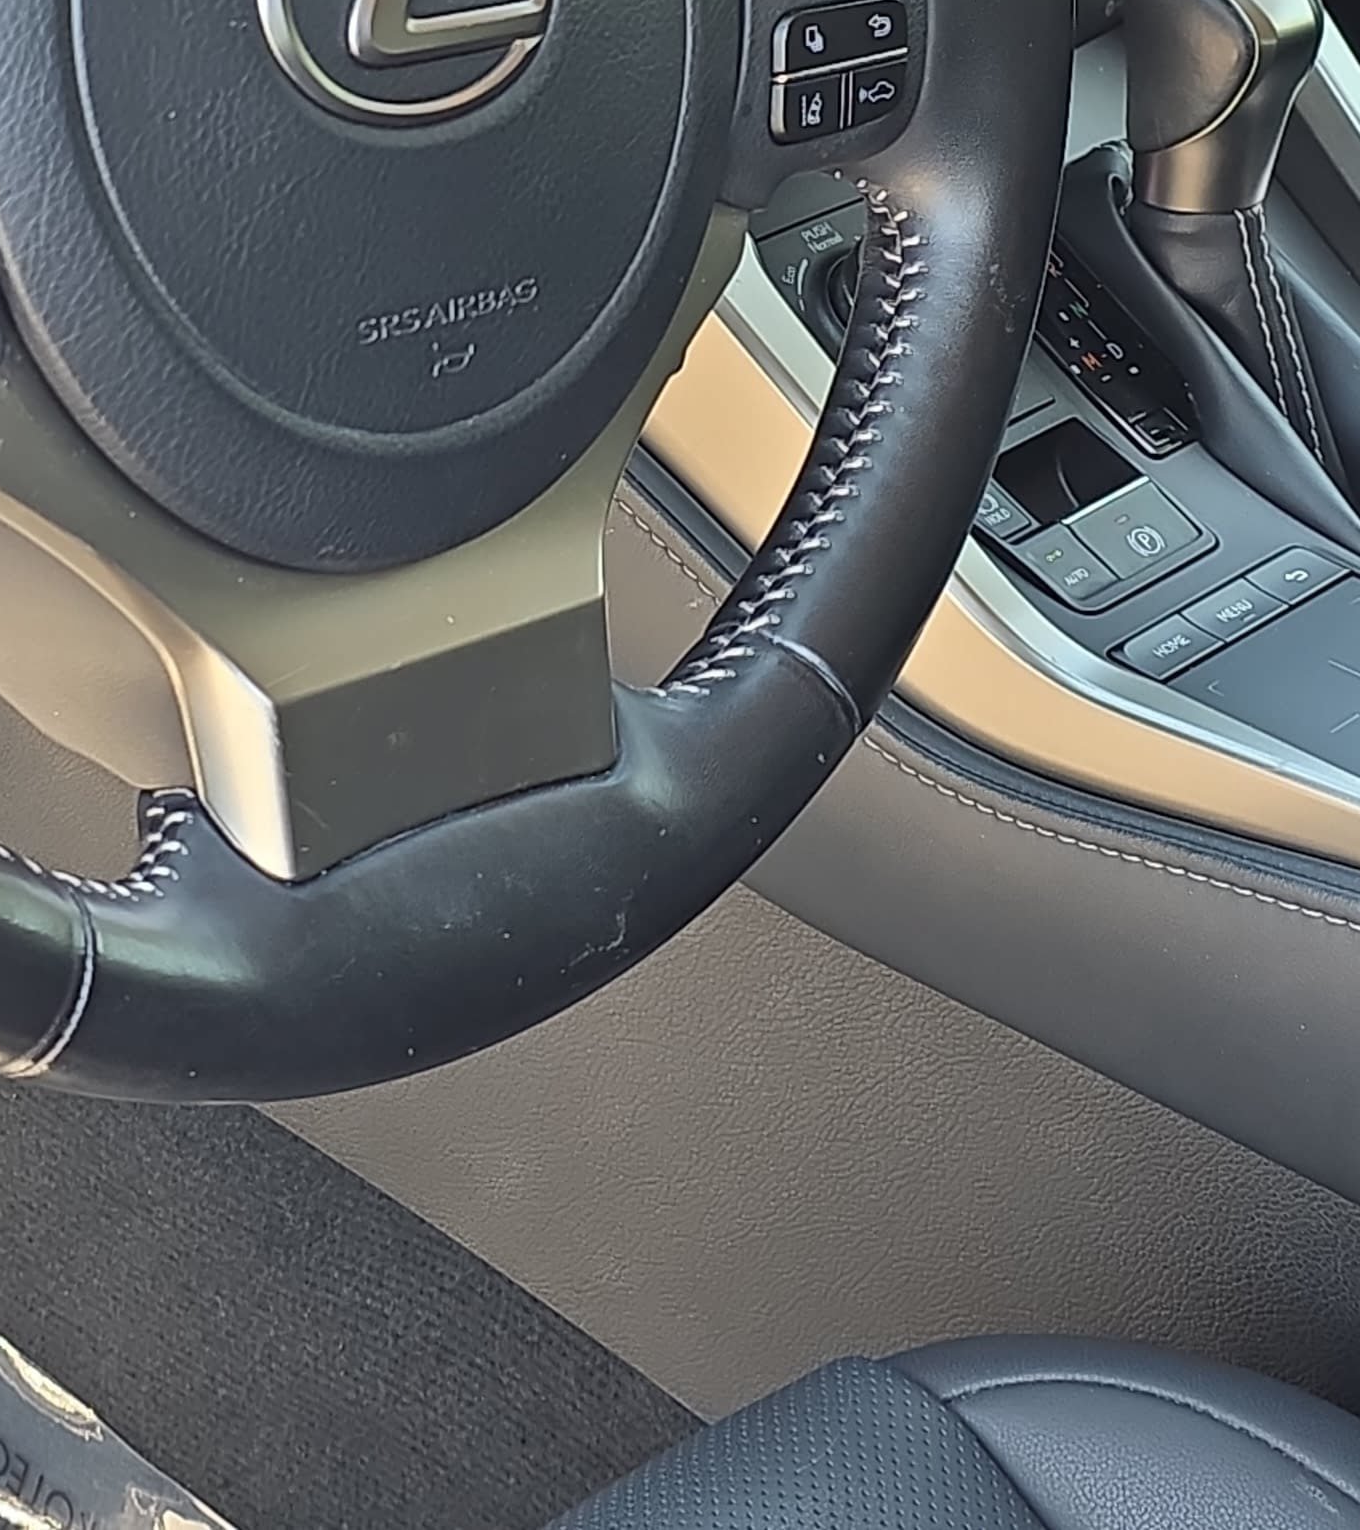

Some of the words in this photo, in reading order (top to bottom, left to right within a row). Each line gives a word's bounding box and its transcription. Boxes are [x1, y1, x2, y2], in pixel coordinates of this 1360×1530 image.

[357, 307, 421, 346] SRS
[423, 277, 538, 330] AIRBAG
[1081, 351, 1102, 371] M
[1105, 342, 1125, 360] D
[1063, 567, 1089, 586] AUTO
[1215, 598, 1253, 623] MENU
[1152, 634, 1191, 659] HOME
